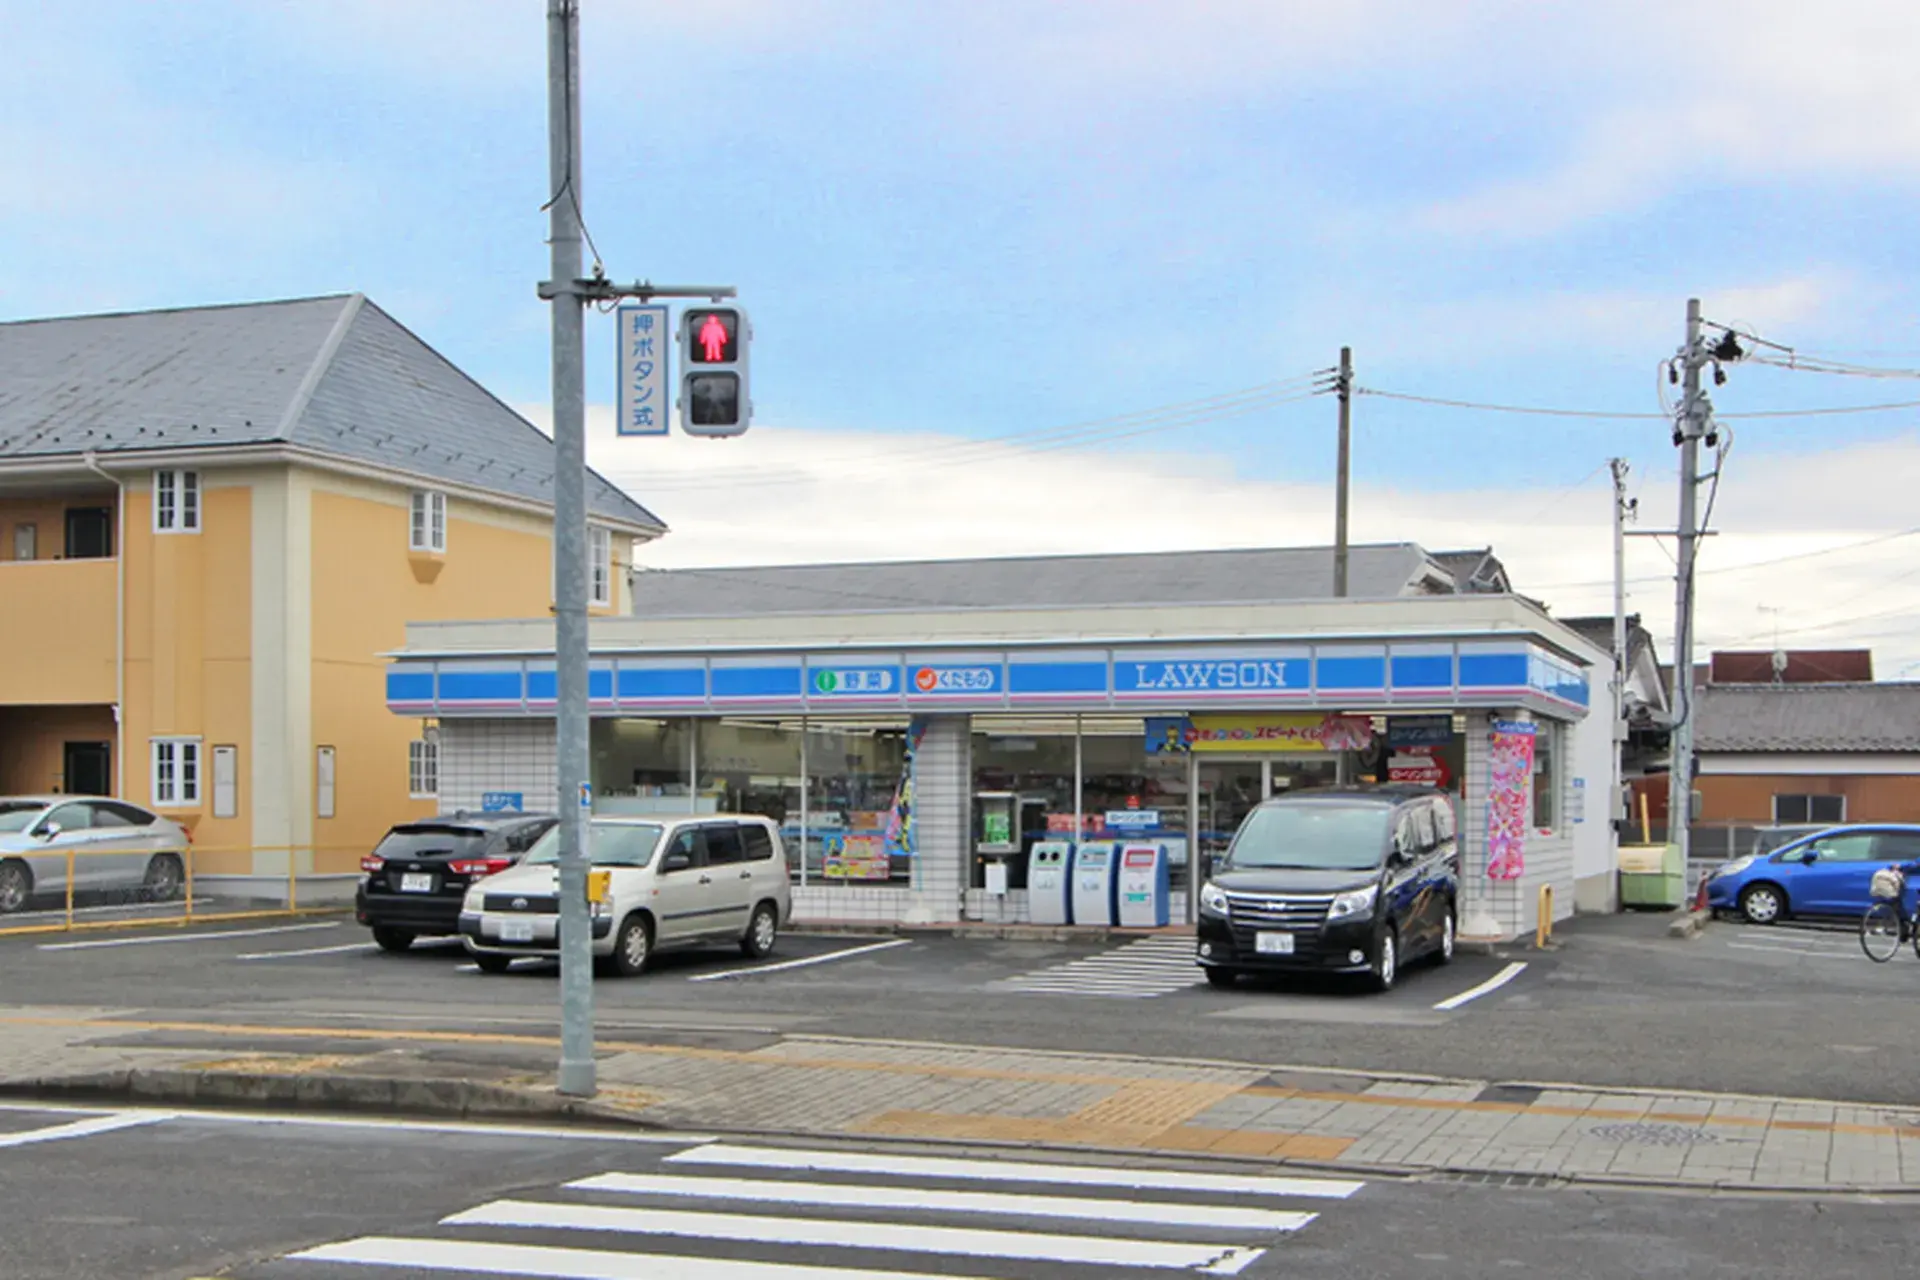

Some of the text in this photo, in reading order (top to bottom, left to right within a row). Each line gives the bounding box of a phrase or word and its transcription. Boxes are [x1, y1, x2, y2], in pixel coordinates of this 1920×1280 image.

[632, 314, 654, 427] 押ボタン式
[1135, 662, 1287, 688] LAWSON
